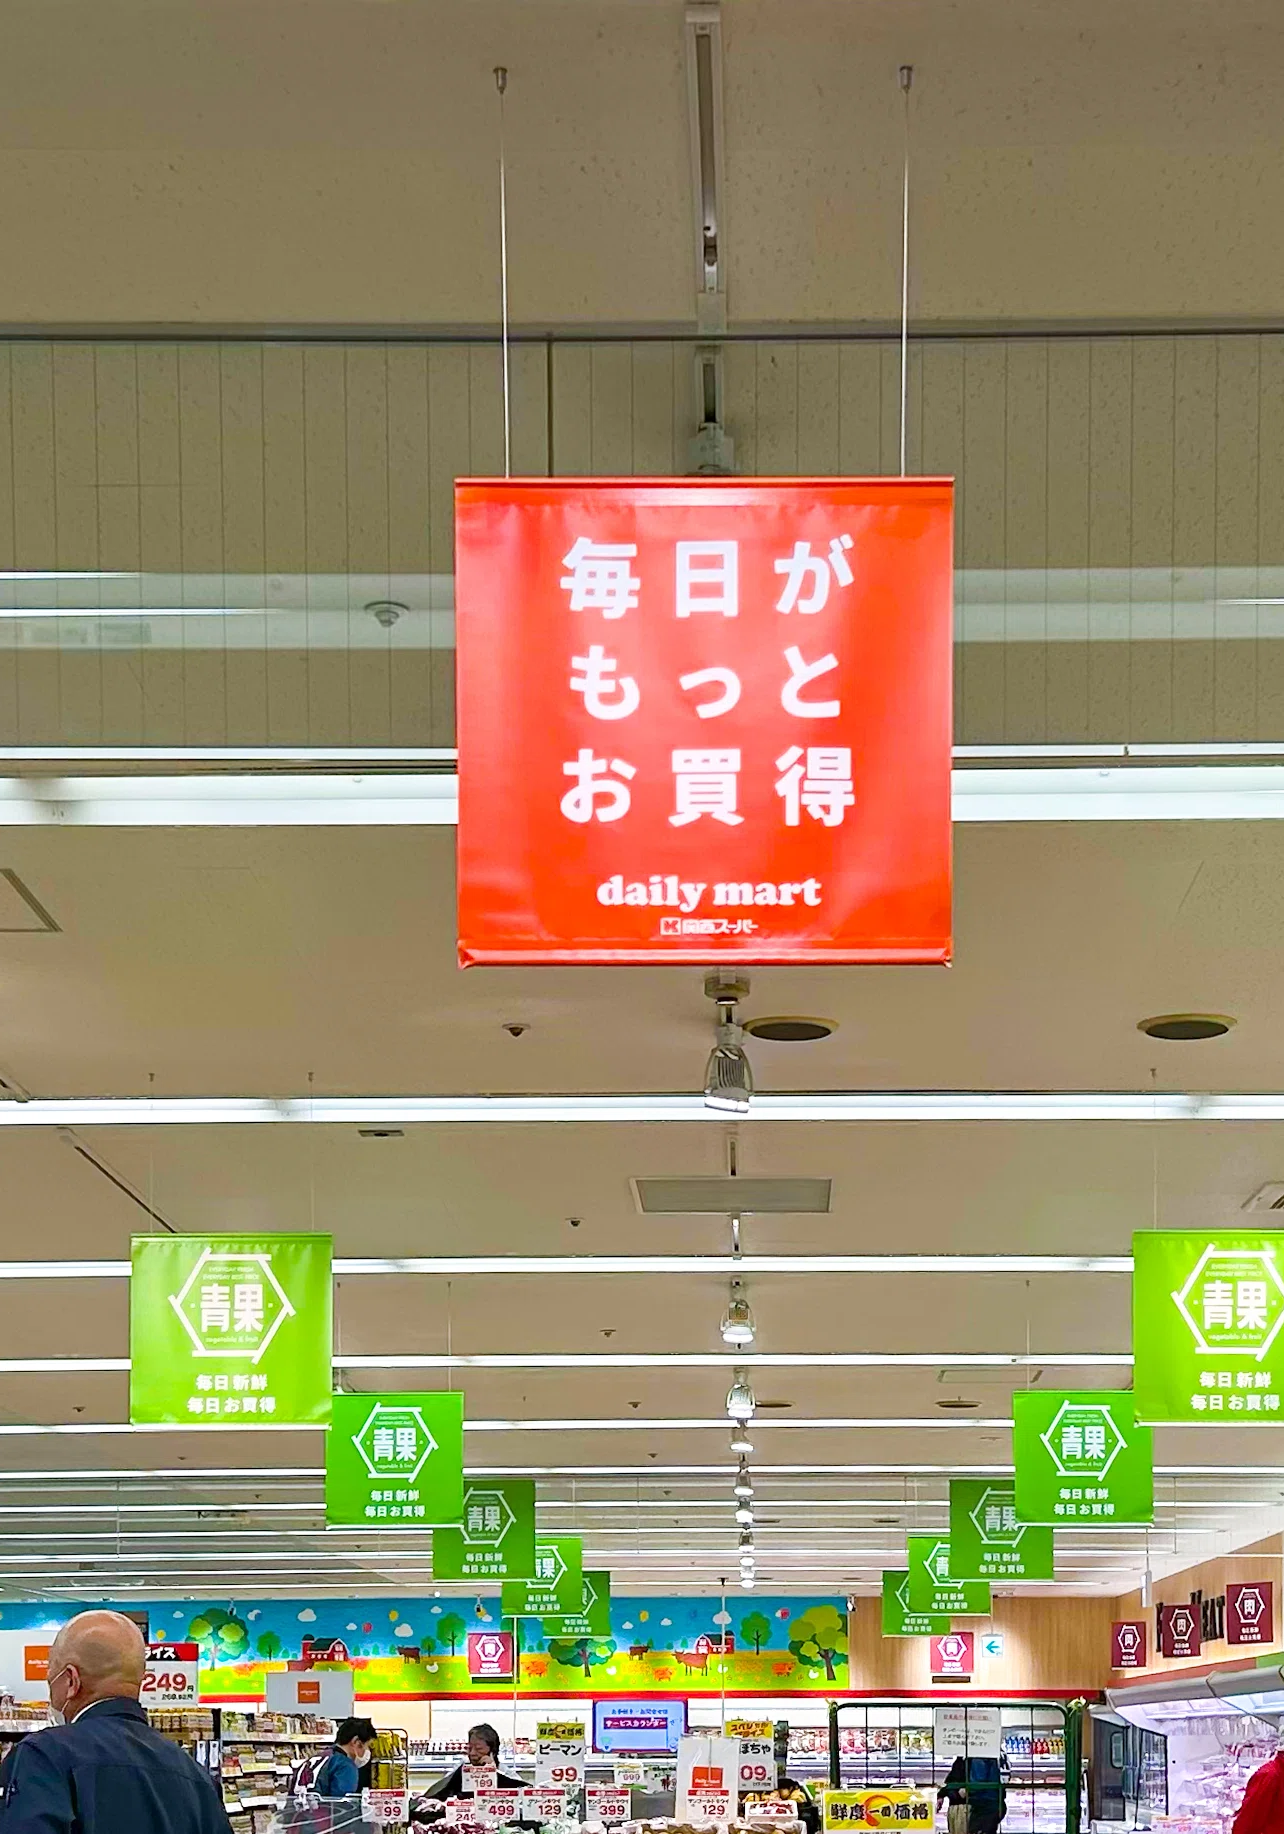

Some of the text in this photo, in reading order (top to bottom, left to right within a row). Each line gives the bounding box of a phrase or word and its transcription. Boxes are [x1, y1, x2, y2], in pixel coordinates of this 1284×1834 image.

[560, 534, 855, 620] 毎日が
[569, 645, 841, 720] もっと
[559, 745, 855, 828] お買得
[596, 875, 823, 913] daily mart
[200, 1283, 264, 1333] 青果
[1203, 1280, 1267, 1330] 青果
[373, 1427, 417, 1462] 青果
[1061, 1425, 1106, 1460] 青果
[467, 1506, 501, 1532] 青果
[985, 1505, 1018, 1532] 青果
[142, 1673, 186, 1692] 249
[539, 1744, 582, 1756] ピーマン
[551, 1766, 577, 1782] 99
[488, 1805, 514, 1816] 499
[538, 1805, 561, 1816] 129
[599, 1805, 625, 1816] 399
[702, 1804, 725, 1815] 129
